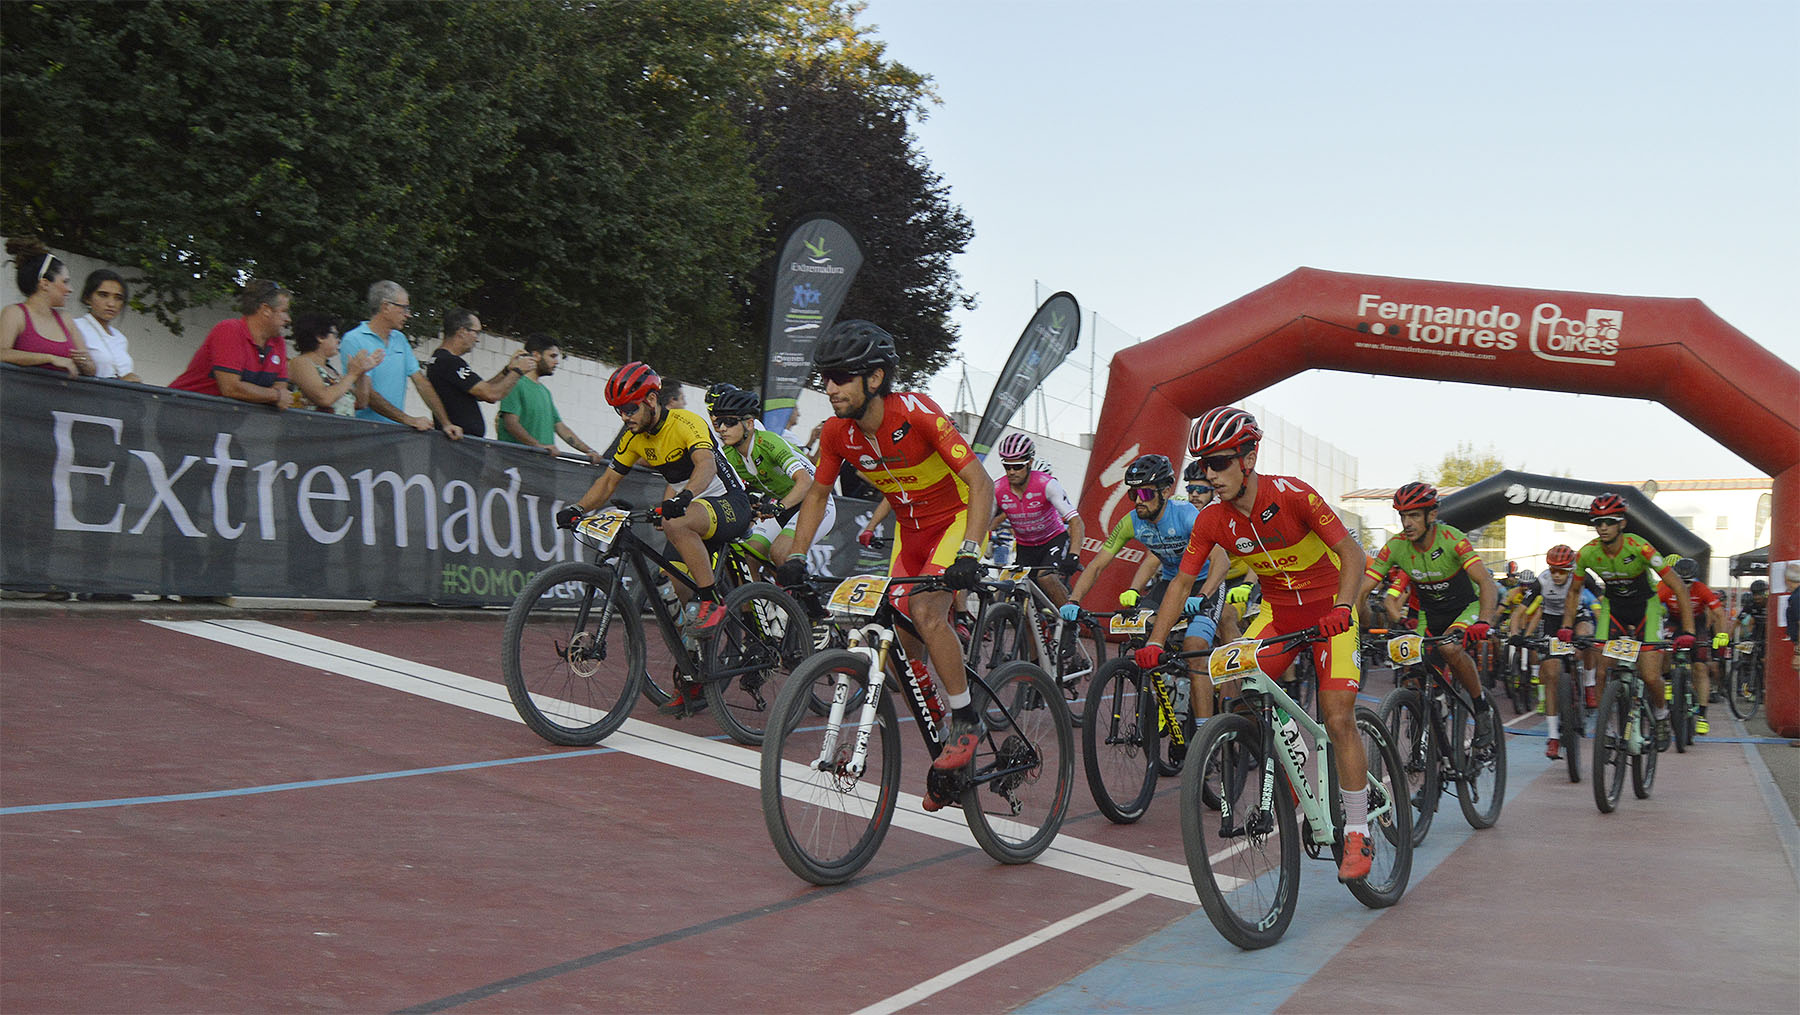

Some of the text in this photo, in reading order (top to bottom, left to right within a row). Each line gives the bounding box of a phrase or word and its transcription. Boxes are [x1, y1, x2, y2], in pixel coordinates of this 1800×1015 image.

[1357, 294, 1521, 331] Fernando
[1406, 320, 1518, 351] torres
[52, 410, 620, 566] Extremadur
[588, 513, 617, 533] 22
[740, 561, 773, 638] STVENS
[849, 582, 870, 604] 5
[1226, 647, 1241, 671] 2
[1399, 641, 1409, 658] 6
[1152, 671, 1185, 746] NDRAKER
[1259, 773, 1275, 812] ROCKSHOX
